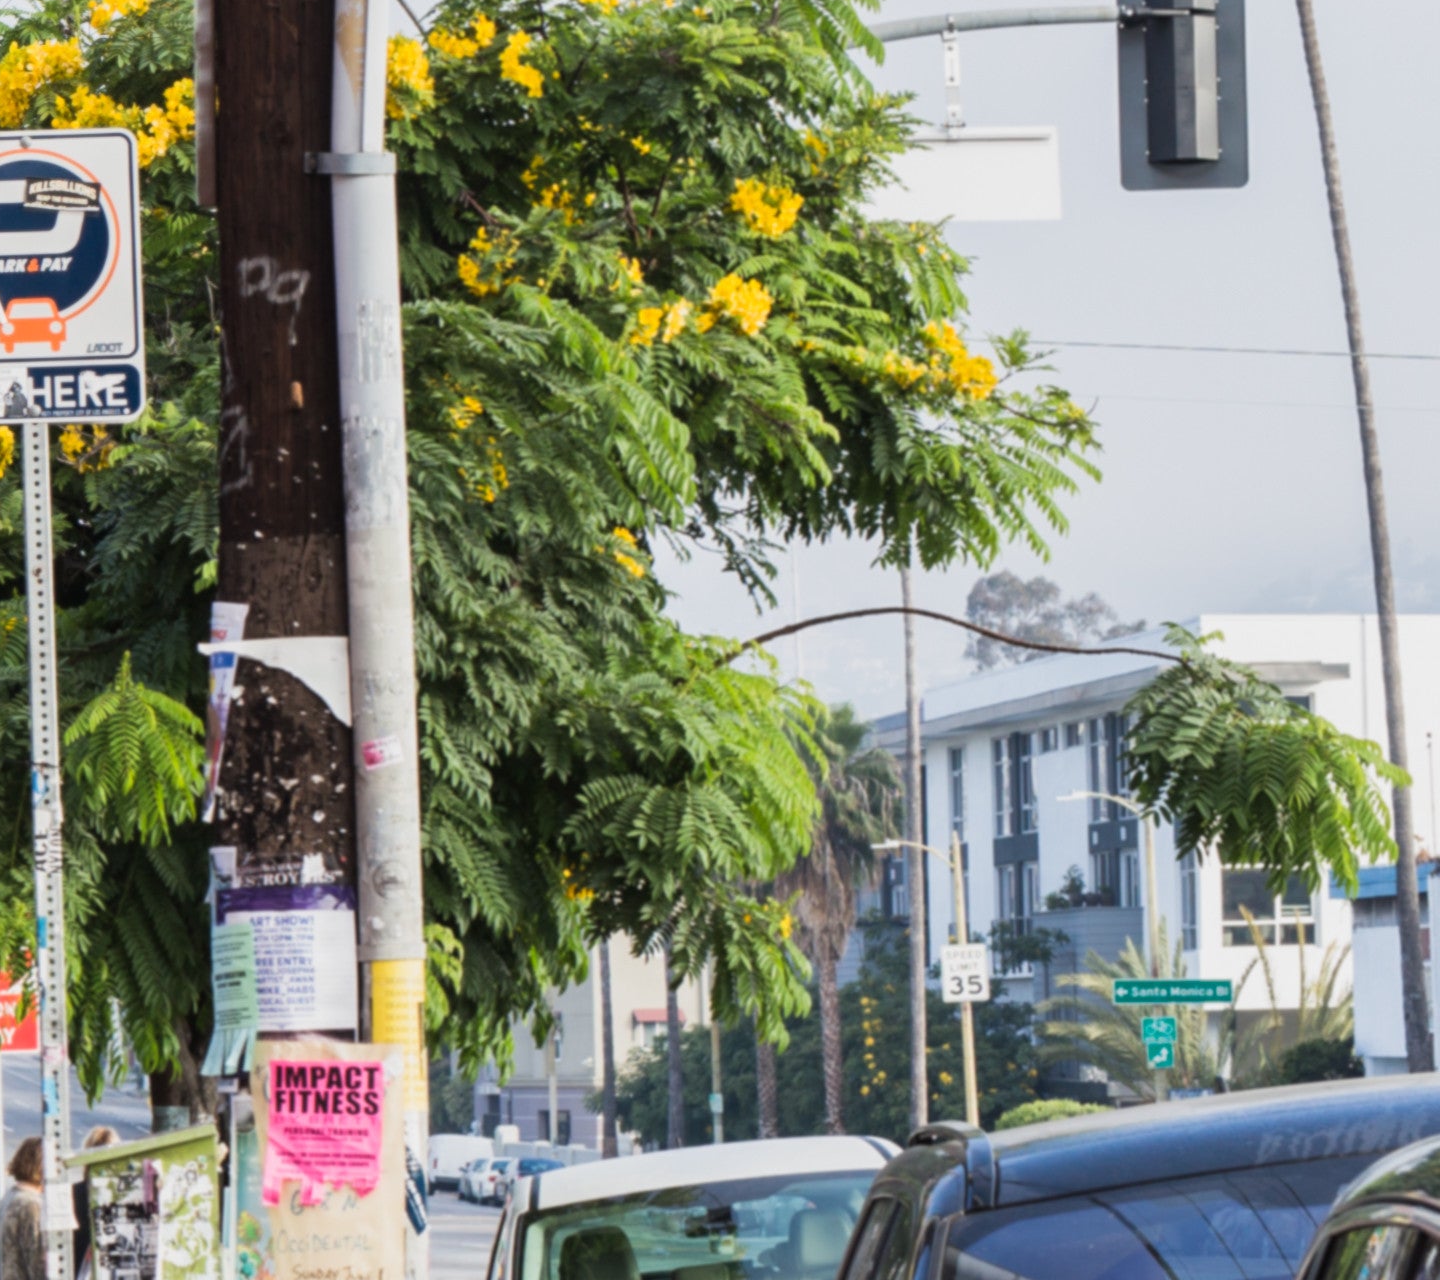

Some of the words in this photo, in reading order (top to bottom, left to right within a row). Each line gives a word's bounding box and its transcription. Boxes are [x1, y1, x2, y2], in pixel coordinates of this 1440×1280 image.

[27, 257, 39, 272] &
[40, 256, 72, 271] PAY
[28, 371, 129, 408] HERE
[946, 950, 981, 960] SPEED
[950, 962, 978, 971] LIMIT
[950, 974, 982, 995] 35
[1131, 985, 1167, 997] Santa
[1170, 984, 1213, 997] Monica
[275, 1066, 379, 1090] IMPACT
[274, 1090, 379, 1116] FITNESS
